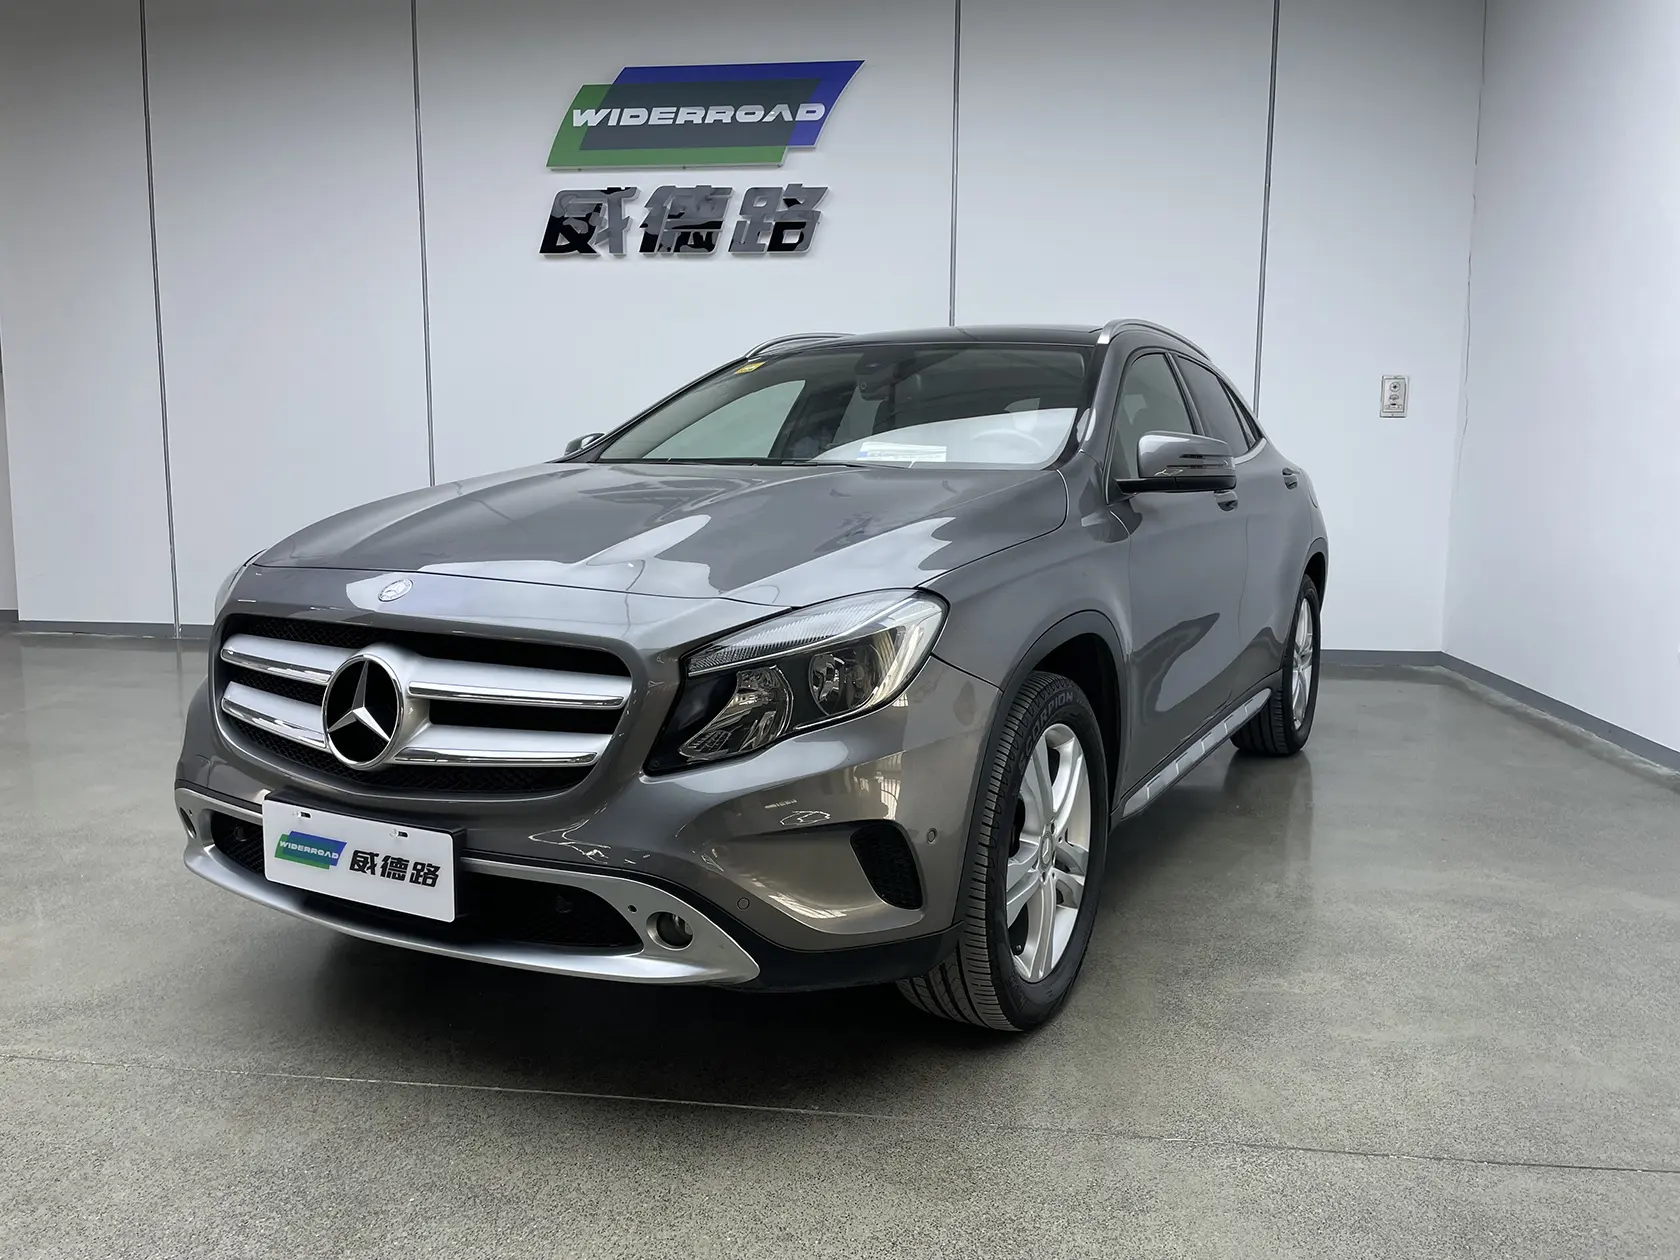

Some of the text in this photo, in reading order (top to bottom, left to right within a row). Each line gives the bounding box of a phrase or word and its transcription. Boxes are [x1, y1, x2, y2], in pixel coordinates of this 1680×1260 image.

[572, 103, 826, 127] WIDERROAD
[539, 183, 829, 256] 威德路
[279, 840, 340, 860] WIDERROAD
[349, 850, 441, 888] 威德路
